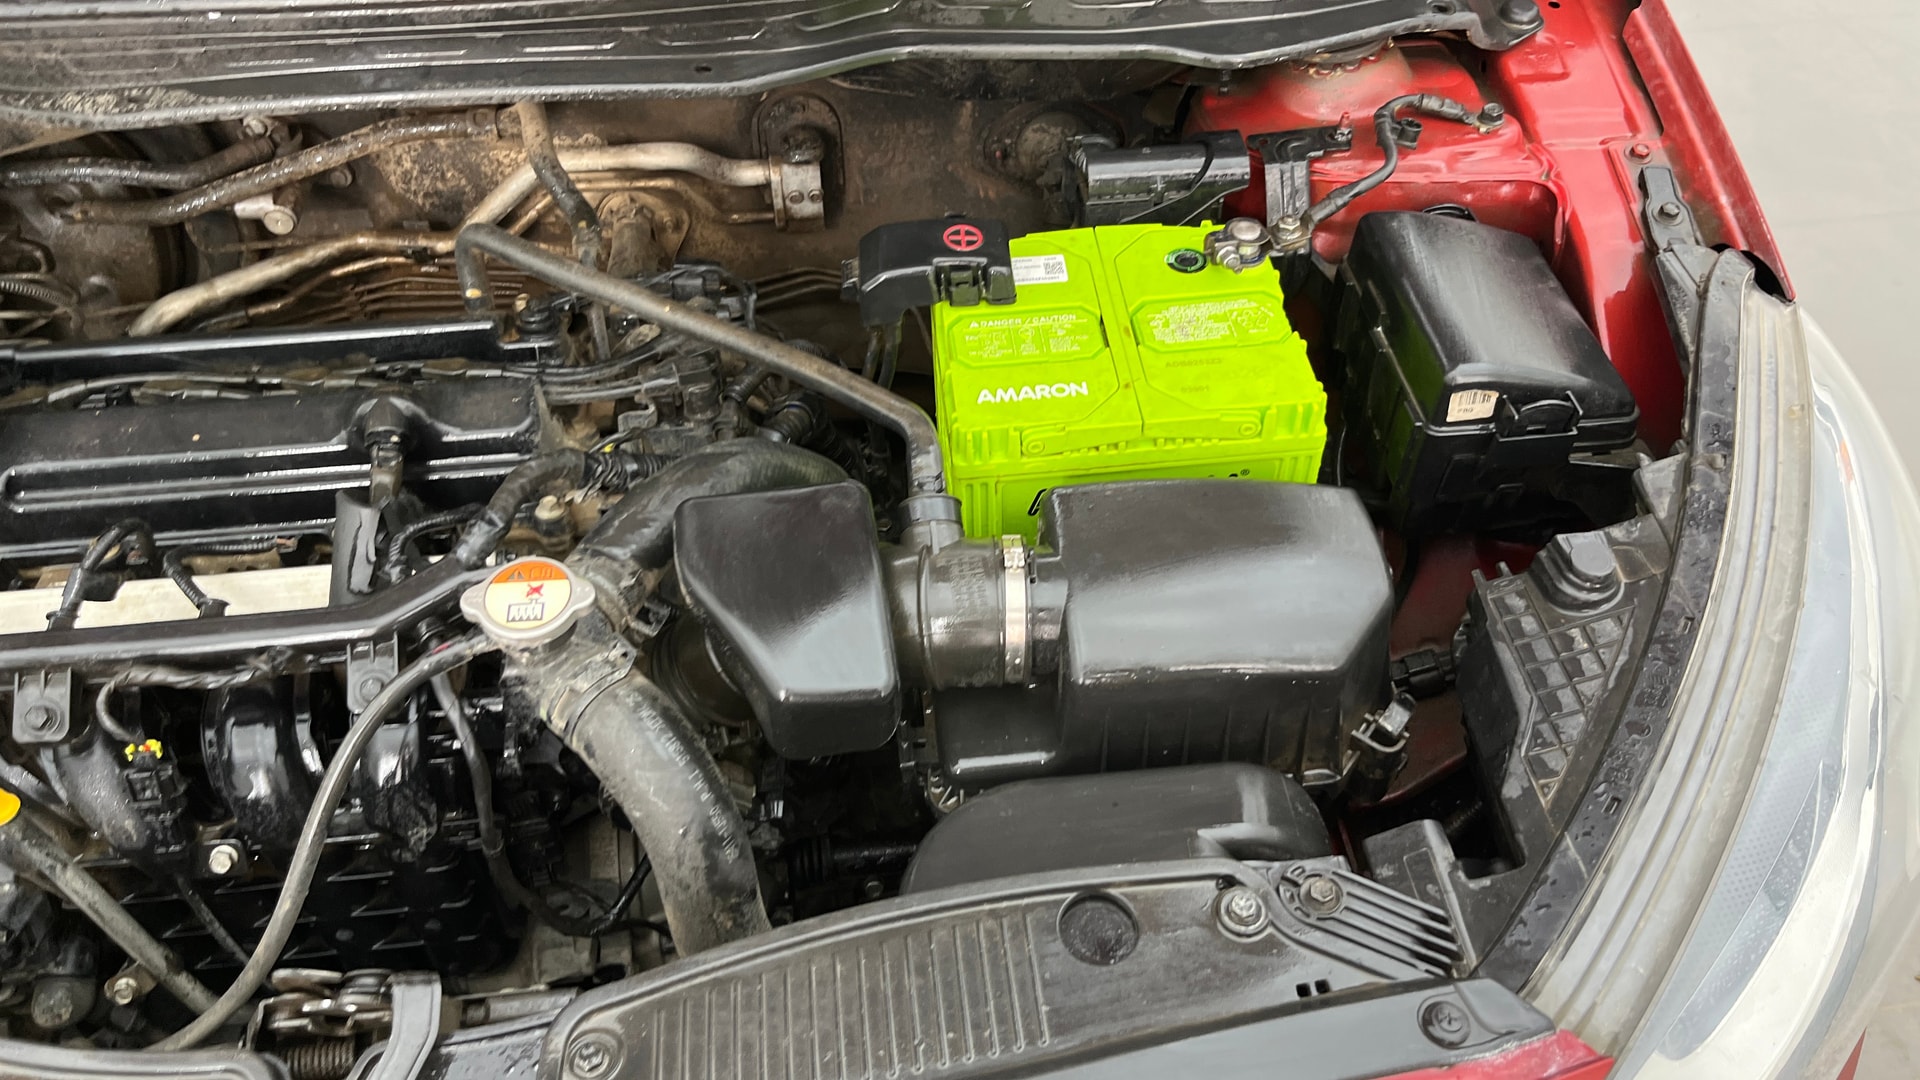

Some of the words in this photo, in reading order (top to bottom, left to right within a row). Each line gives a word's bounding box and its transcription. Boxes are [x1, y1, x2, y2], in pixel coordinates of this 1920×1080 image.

[979, 318, 1022, 328] DANGER
[1032, 314, 1077, 324] CAUTION
[977, 381, 1089, 404] AMARON
